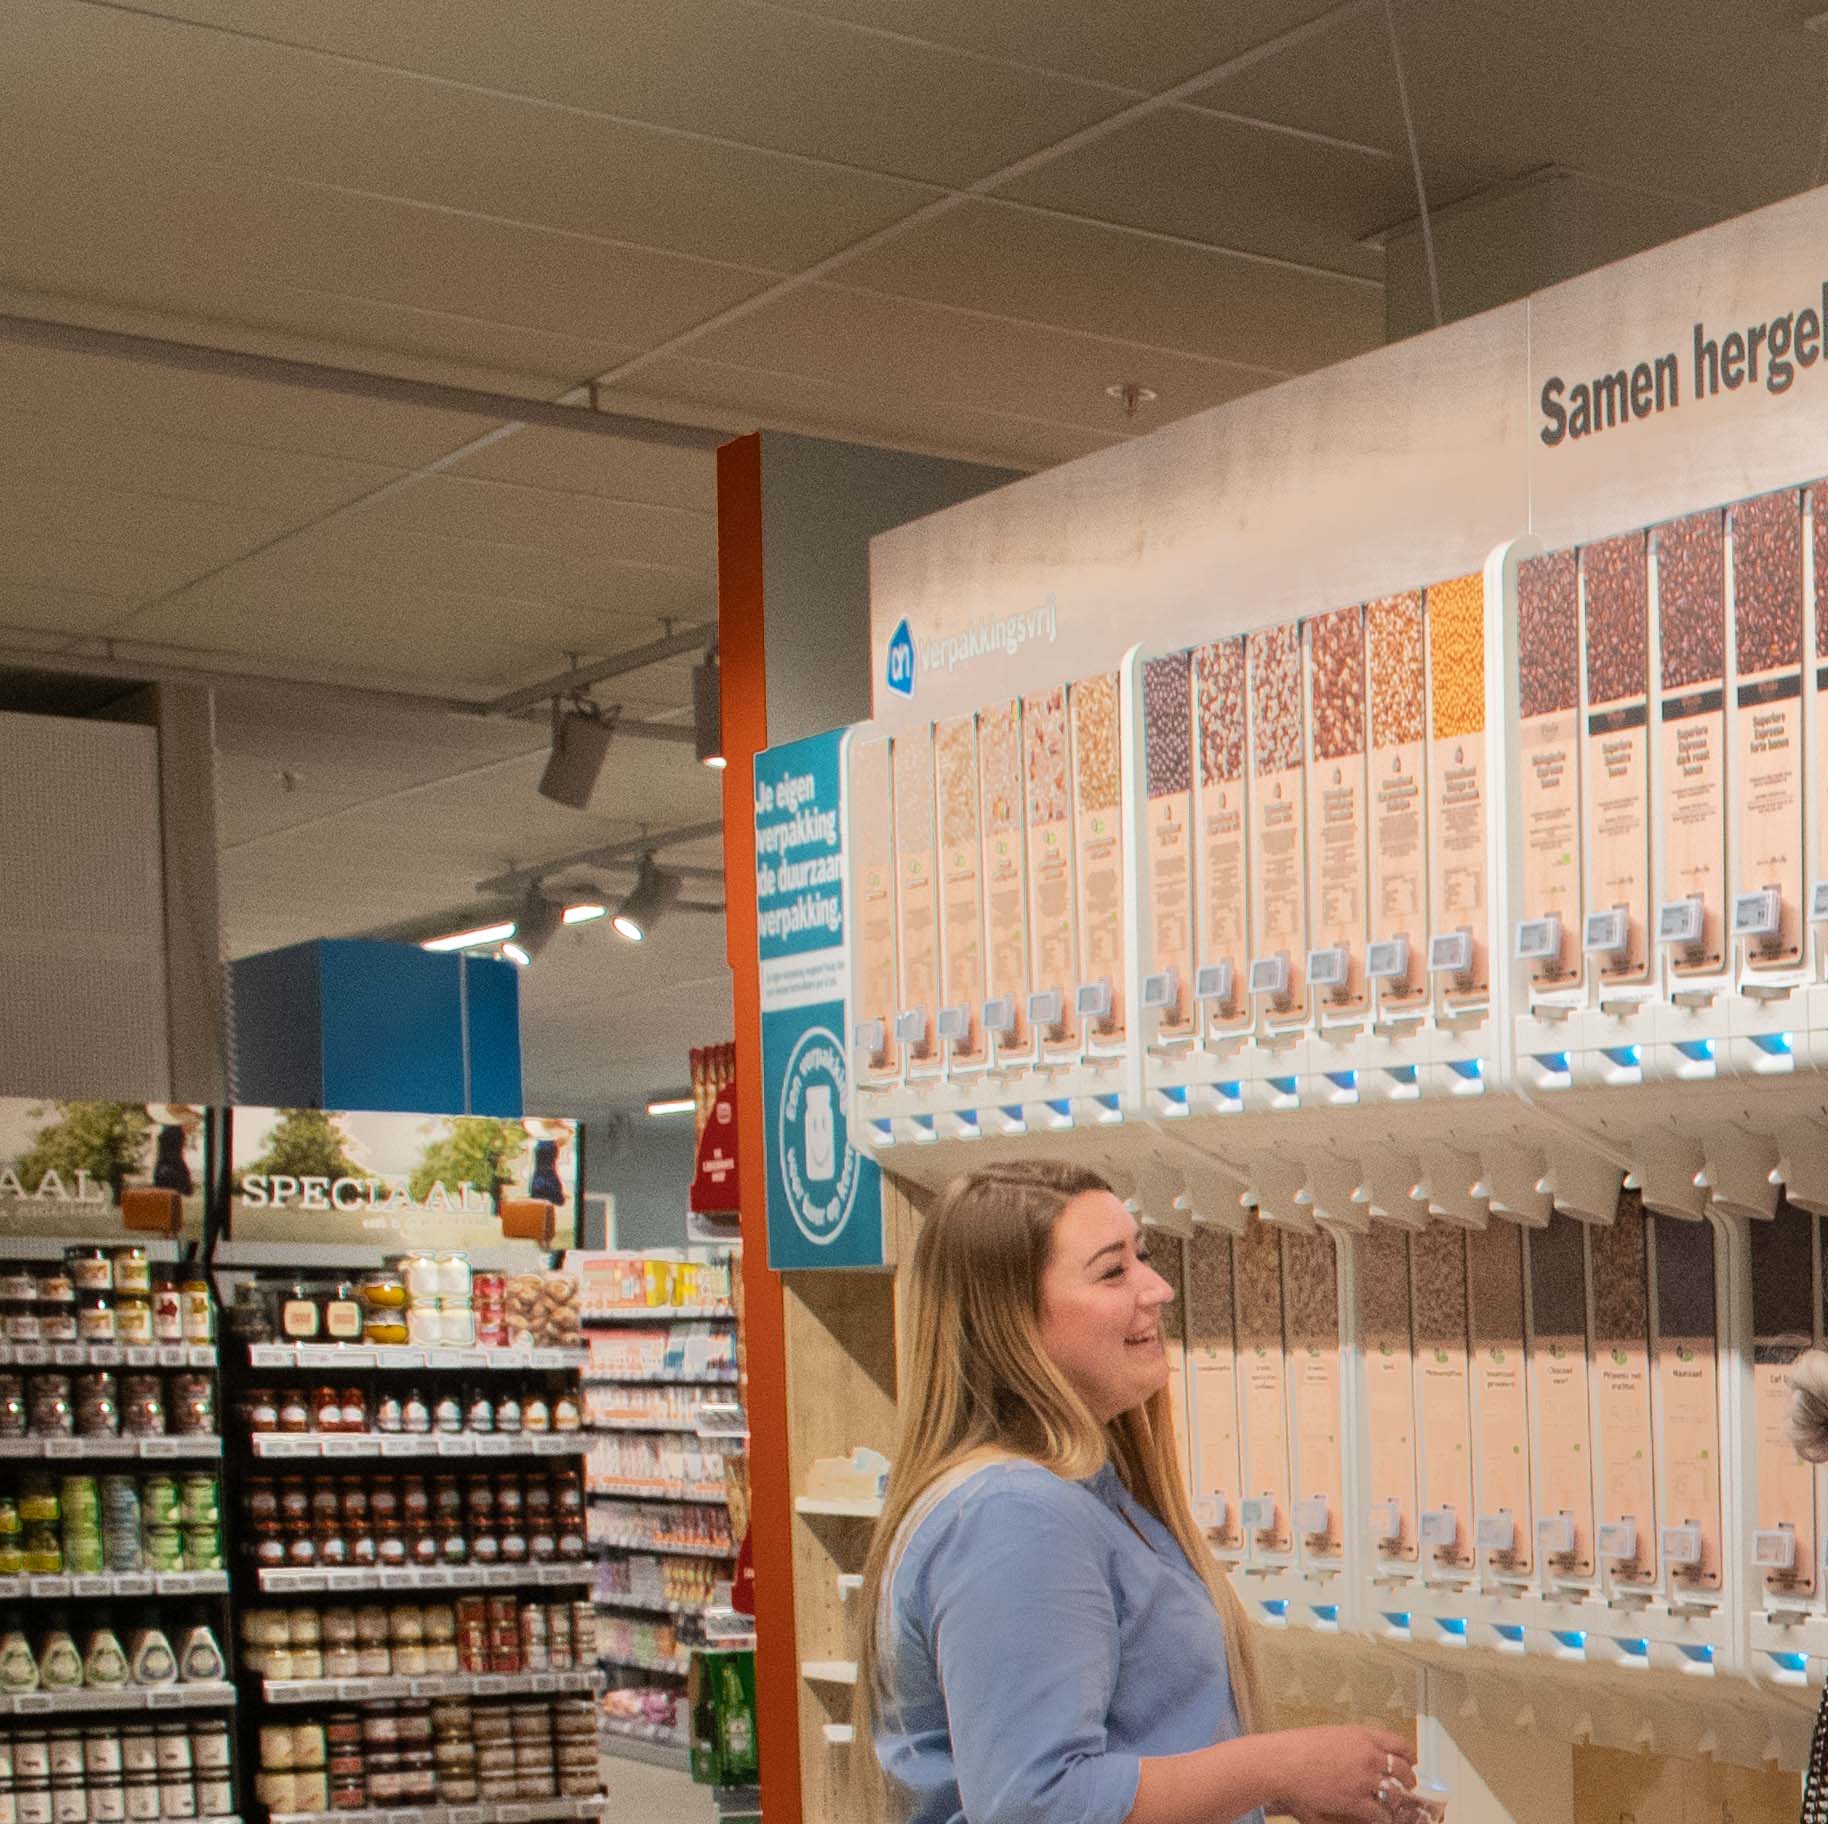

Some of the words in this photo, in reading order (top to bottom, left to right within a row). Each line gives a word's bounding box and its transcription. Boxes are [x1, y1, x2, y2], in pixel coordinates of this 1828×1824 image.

[1539, 351, 1680, 448] Samen
[920, 592, 1056, 672] Verpakkingsvrij
[756, 780, 773, 813] Je
[776, 773, 814, 812] eigen
[757, 808, 836, 857] verpakking
[757, 862, 775, 896] de
[759, 894, 842, 940] verpakking.
[242, 1175, 490, 1212] SPECIAAL
